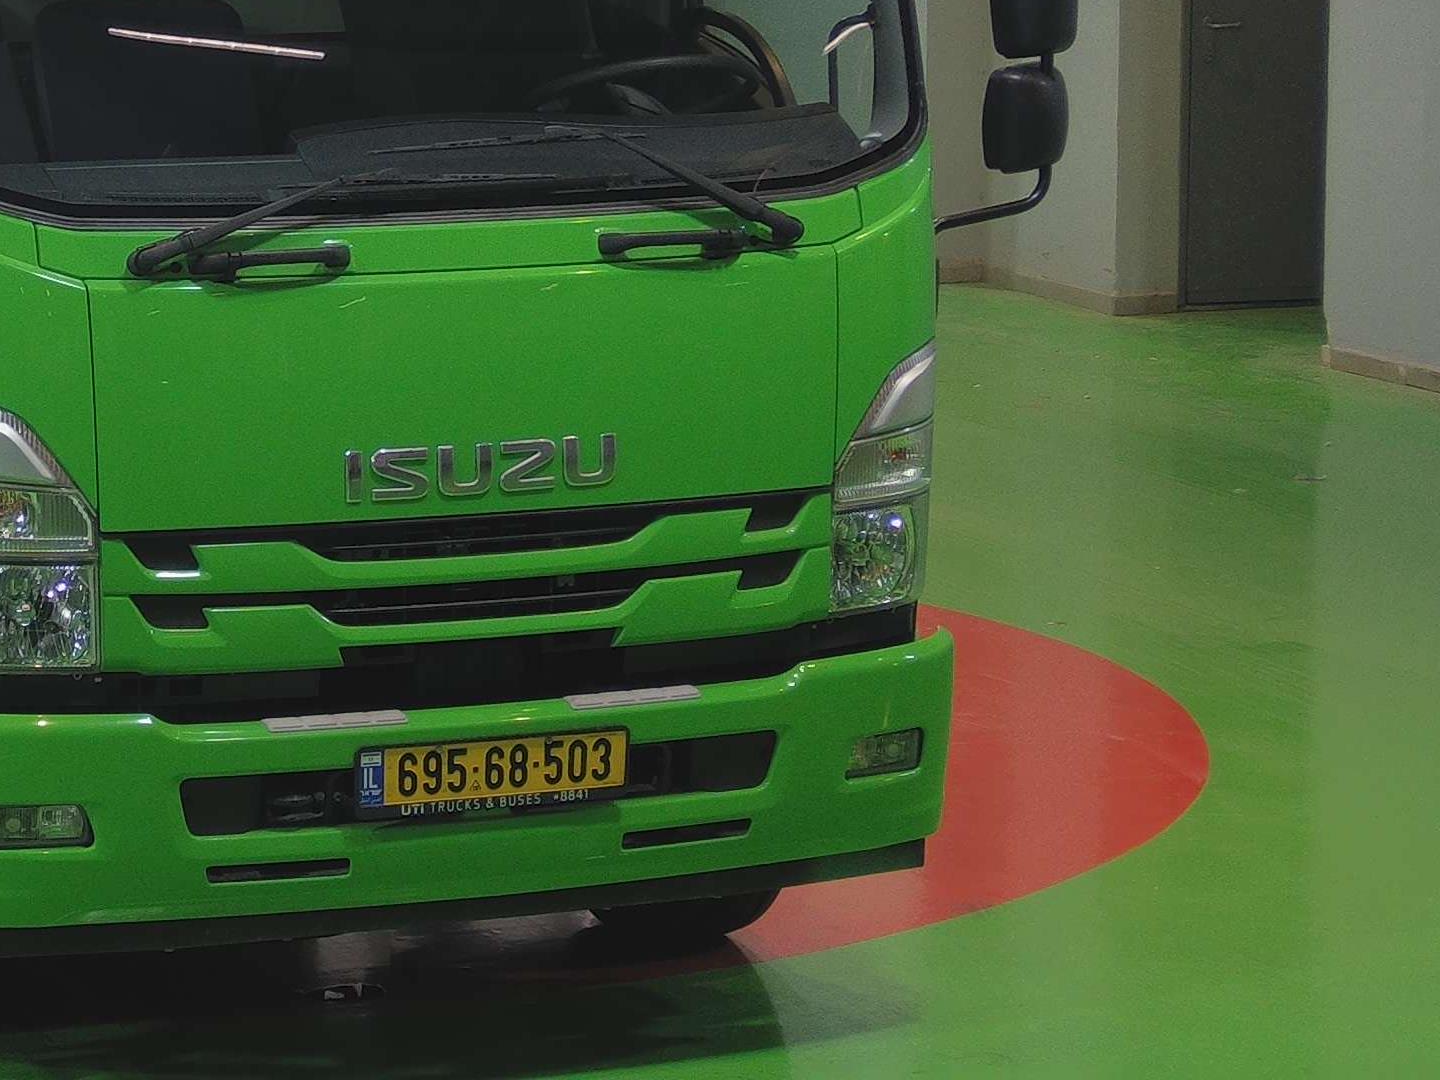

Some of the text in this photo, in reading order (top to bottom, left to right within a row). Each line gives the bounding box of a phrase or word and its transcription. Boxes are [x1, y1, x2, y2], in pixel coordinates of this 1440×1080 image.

[345, 432, 617, 504] ISUZU
[364, 768, 378, 788] IL
[430, 798, 481, 813] TRUCKS
[486, 797, 495, 809] &
[500, 793, 542, 808] BUSES
